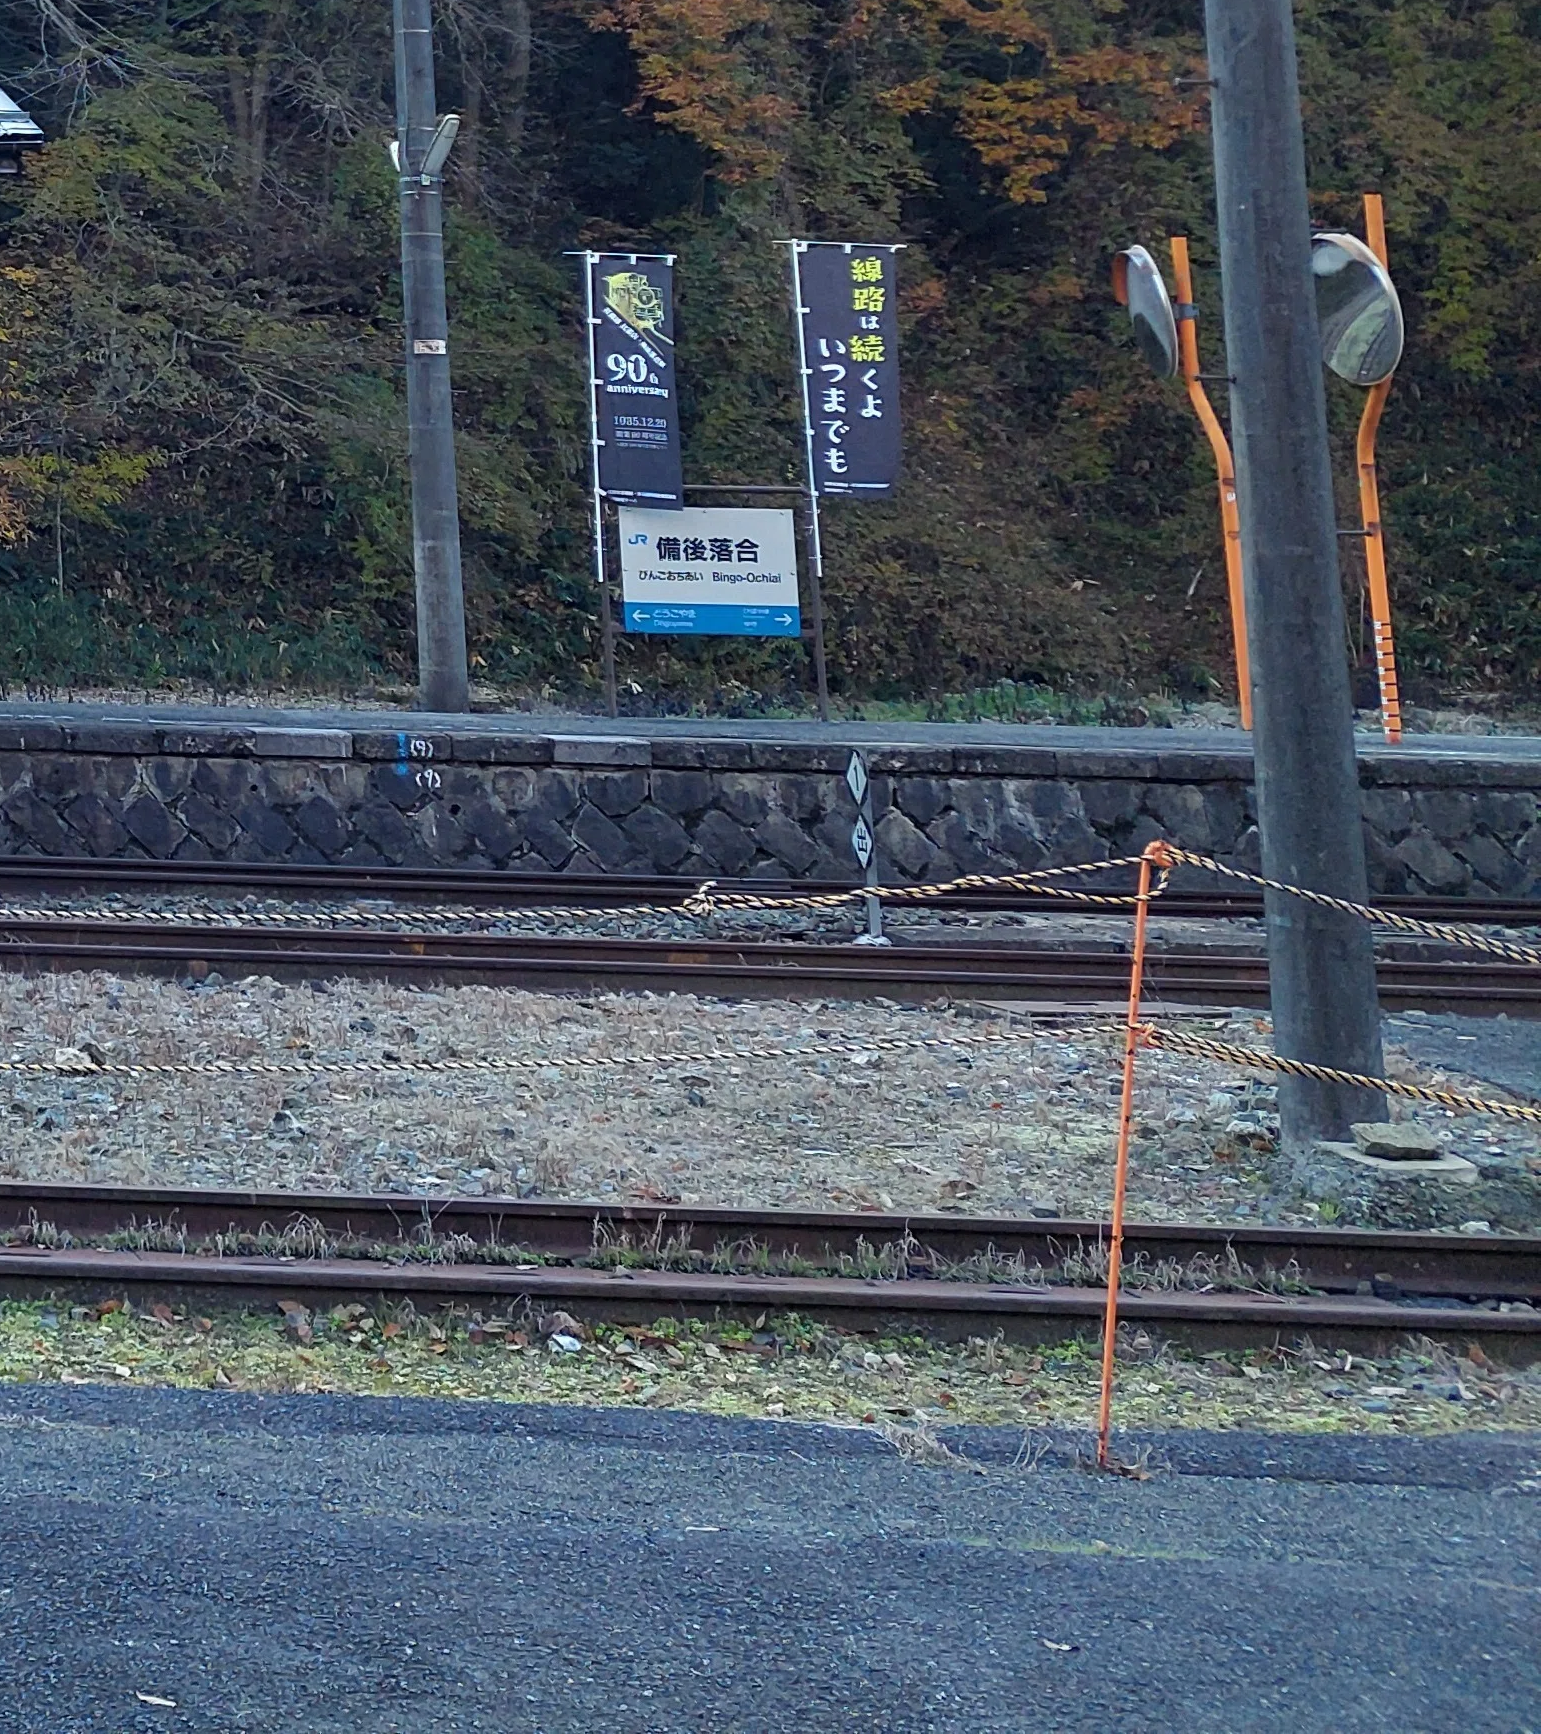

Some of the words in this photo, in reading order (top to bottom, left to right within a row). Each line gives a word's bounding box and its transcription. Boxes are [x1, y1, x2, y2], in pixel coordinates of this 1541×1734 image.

[849, 256, 886, 419] 線路は続くよ
[819, 338, 850, 474] いつまでも
[628, 534, 648, 545] JR
[656, 536, 760, 563] 備後落合
[712, 572, 782, 584] Bingo-Ochiai
[853, 764, 860, 792] 1
